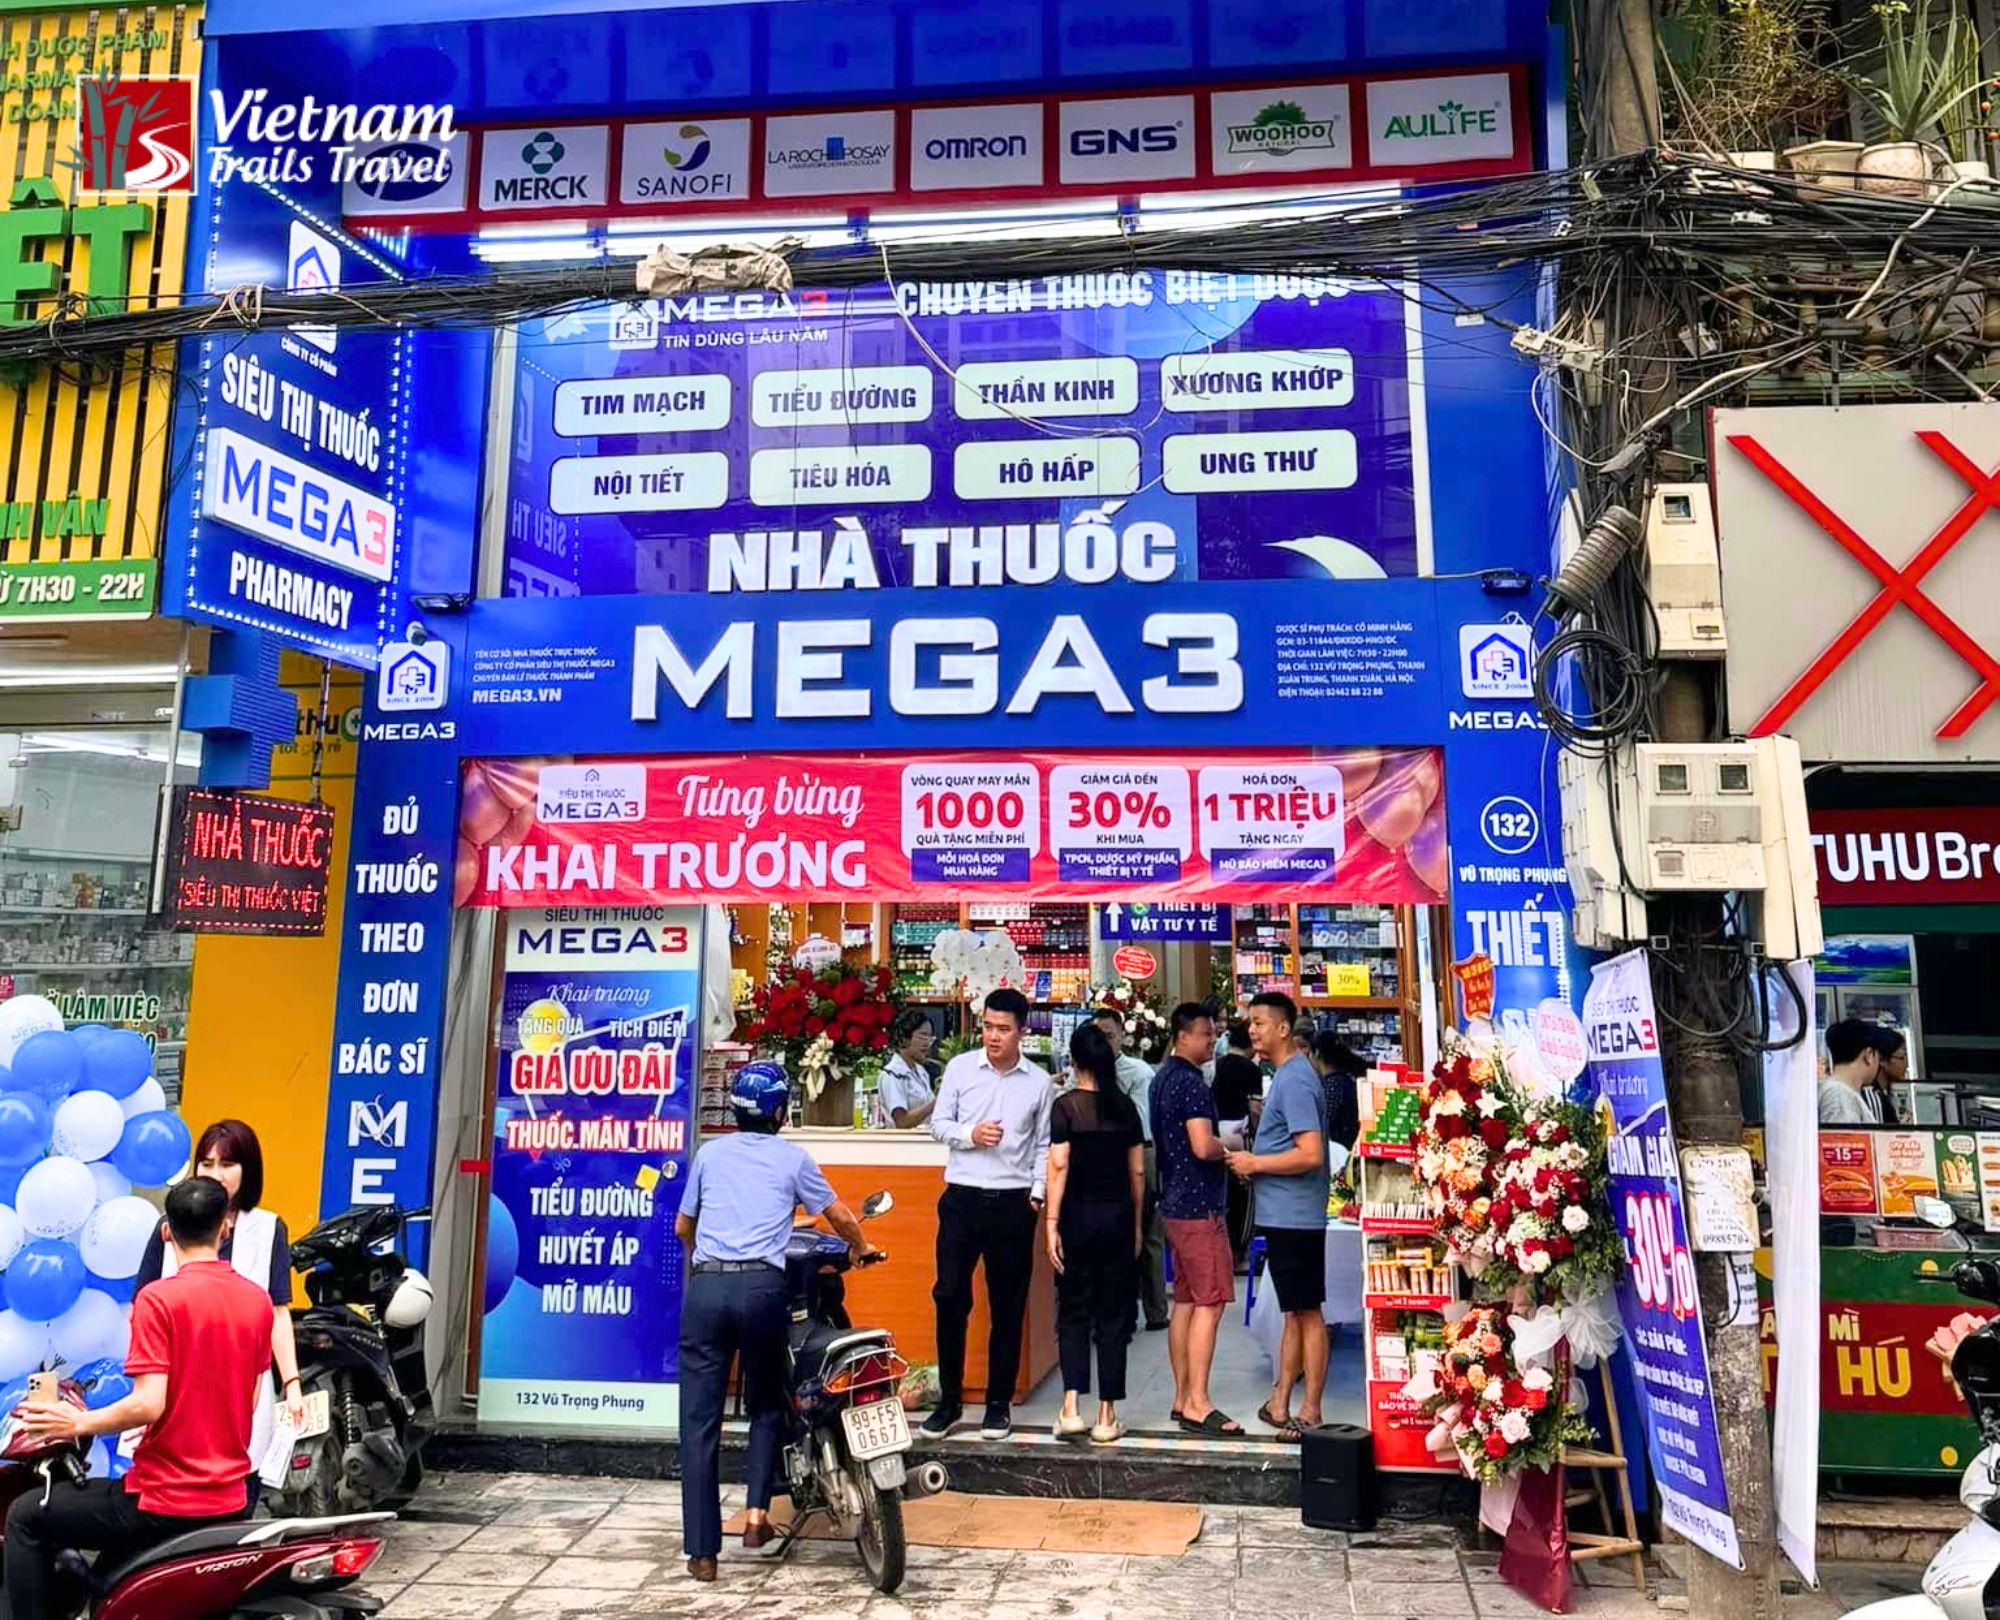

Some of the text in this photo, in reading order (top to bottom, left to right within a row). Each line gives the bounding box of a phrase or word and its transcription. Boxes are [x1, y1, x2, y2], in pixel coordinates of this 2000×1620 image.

[1234, 124, 1325, 143] WOOHOO
[1383, 104, 1497, 139] AULIFE
[1069, 125, 1176, 156] GNS
[494, 173, 588, 202] MERCK
[637, 173, 731, 197] SANOFI
[663, 291, 827, 323] MEGA3
[664, 326, 828, 348] TIN DÙNG LÂU NĂM
[978, 375, 1115, 404] THẦN KINH
[1170, 366, 1344, 396] XƯƠNG KHỚP
[221, 351, 380, 473] SIÊU THỊ THUỐC
[582, 390, 705, 417] TIM MẠCH
[768, 382, 917, 413] TIỂU ĐƯỜNG
[790, 461, 891, 489] TIÊU HÓA
[1000, 453, 1095, 484] HÔ HẤP
[1200, 449, 1318, 475] UNG THƯ
[594, 465, 685, 500] NỘI TIẾT
[42, 490, 110, 538] VÂN
[222, 445, 387, 565] MEGA3
[708, 500, 1178, 593] NHÀ THUỐC
[17, 575, 76, 604] 7H30
[97, 572, 146, 601] 22H
[229, 551, 353, 631] PHARMACY
[631, 612, 1244, 722] MEGA3
[472, 687, 562, 703] MEGA3.VN
[364, 721, 456, 741] MEGA3
[596, 787, 626, 799] THUỐC
[911, 772, 1030, 787] VÒNG QUAY MAY MẮN
[1112, 772, 1132, 785] GIÁ
[1242, 772, 1297, 785] HOÁ ĐƠN
[543, 800, 639, 819] MEGA3
[677, 772, 863, 828] Tưng bừng
[916, 791, 1024, 829] 1000
[1068, 791, 1171, 829] 30%
[1204, 785, 1336, 829] 1 TRIỆU
[383, 795, 419, 836] ĐỦ
[1488, 813, 1531, 838] 132
[194, 799, 324, 869] NHÀ THUỐC
[916, 831, 1025, 847] QUÀ TẶNG MIỄN PHÍ
[1096, 834, 1145, 844] KHI MUA
[1239, 832, 1304, 847] TẶNG NGAY
[486, 832, 866, 892] KHAI TRƯƠNG
[944, 865, 998, 876] MUA HÀNG
[1064, 853, 1094, 865] TPCN,
[1095, 853, 1125, 865] DƯỢC
[1131, 867, 1139, 876] Y
[1140, 864, 1154, 877] TẾ
[1290, 859, 1328, 869] MEGA3
[355, 853, 438, 895] THUỐC
[1459, 865, 1567, 886] VŨ TRỌNG PHỤNG
[585, 907, 608, 924] THỊ
[1131, 914, 1218, 933] VẬT TƯ Y TẾ
[1466, 893, 1565, 966] THIẾT
[360, 921, 425, 953] THEO
[517, 926, 688, 955] MEGA3
[62, 986, 160, 1026] LÀM VIỆC
[363, 980, 419, 1013] ĐƠN
[547, 983, 651, 1007] Khai trương
[556, 1013, 584, 1036] QUÀ
[609, 1013, 688, 1038] TÍCH ĐIỂM
[338, 1037, 428, 1075] BÁC SĨ
[513, 1045, 673, 1091] GIÁ ƯU ĐÃI
[580, 1115, 631, 1152] MÃN
[635, 1113, 685, 1152] TÍNH
[1834, 1147, 1851, 1161] 15
[530, 1177, 654, 1217] TIỂU ĐƯỜNG
[539, 1228, 640, 1266] HUYẾT ÁP
[542, 1278, 632, 1315] MỠ MÁU
[1828, 1308, 1860, 1341] MÌ
[1836, 1336, 1912, 1397] HÚ
[516, 1391, 645, 1411] 132 Vũ Trọng Phụng
[852, 1403, 898, 1431] 99-F5
[858, 1424, 899, 1449] 0667
[195, 1553, 264, 1575] VISION
